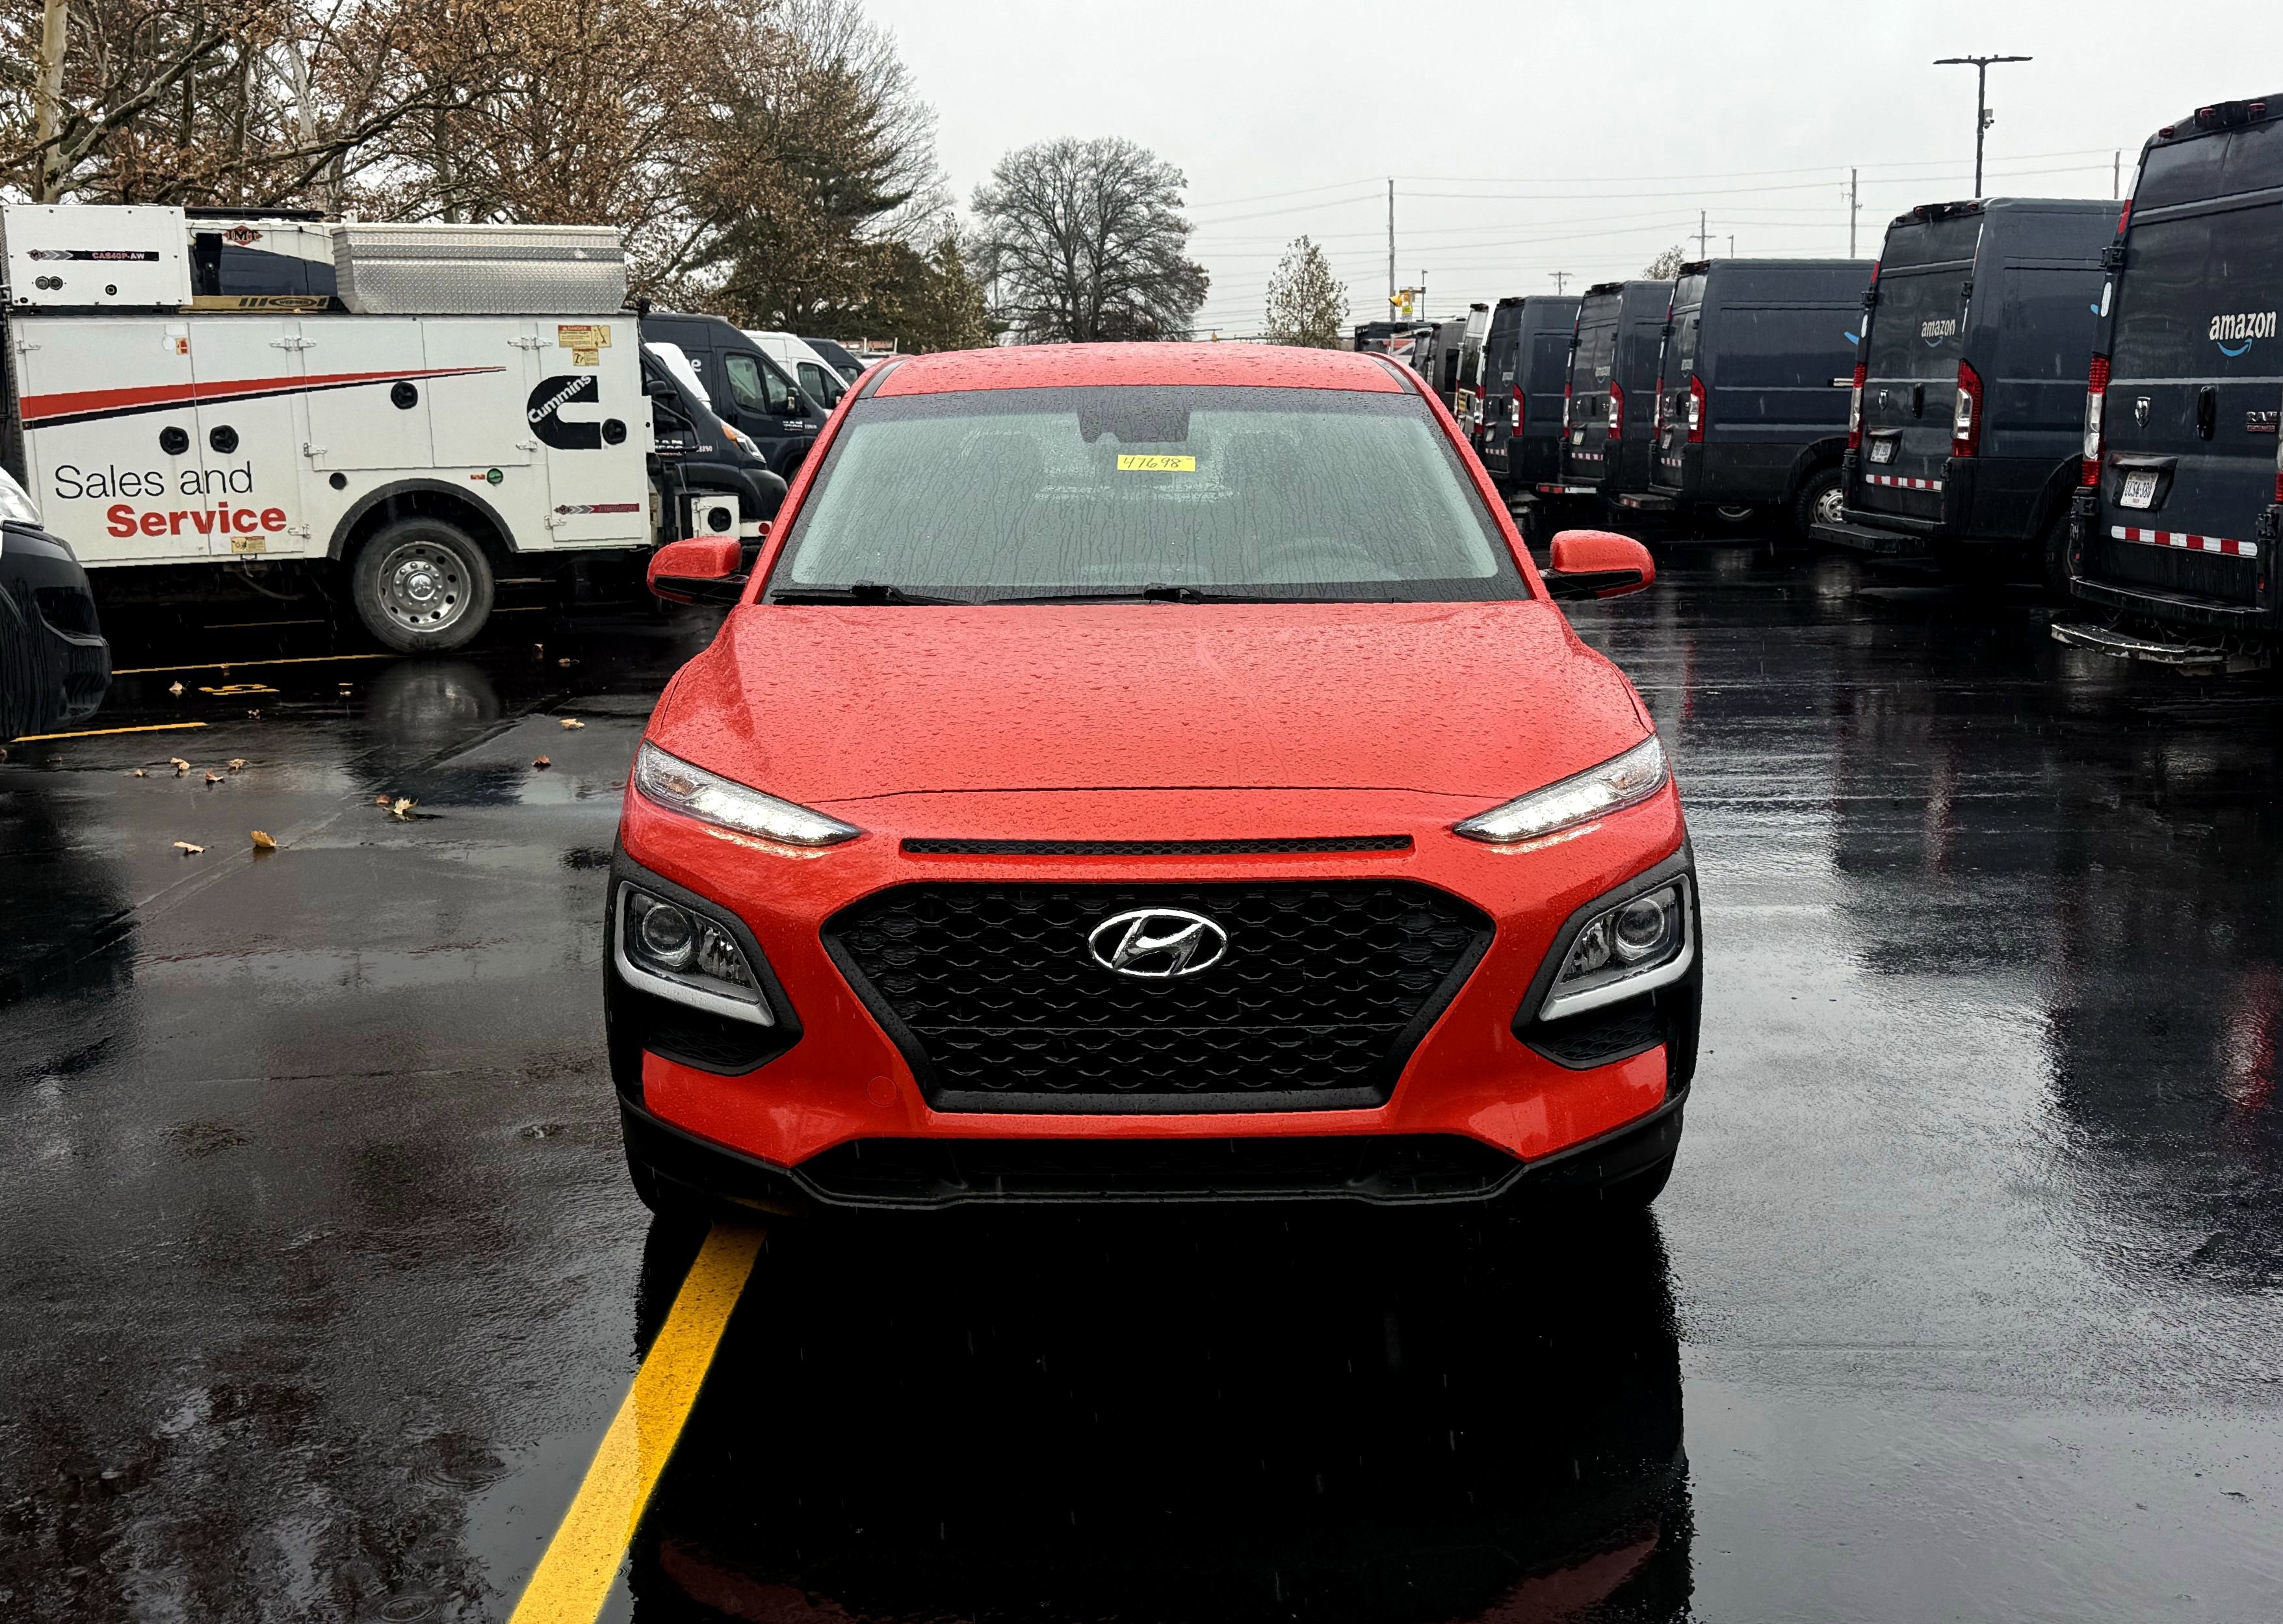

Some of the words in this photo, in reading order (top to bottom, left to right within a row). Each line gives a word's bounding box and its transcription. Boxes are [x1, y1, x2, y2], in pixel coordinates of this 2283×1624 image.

[226, 229, 259, 241] IMT
[1921, 318, 1956, 337] amazon
[2209, 311, 2276, 341] amazon
[528, 375, 592, 423] Cummins
[1123, 456, 1183, 469] 47698
[55, 465, 165, 499] Sales
[179, 460, 254, 495] and
[106, 500, 287, 538] Service
